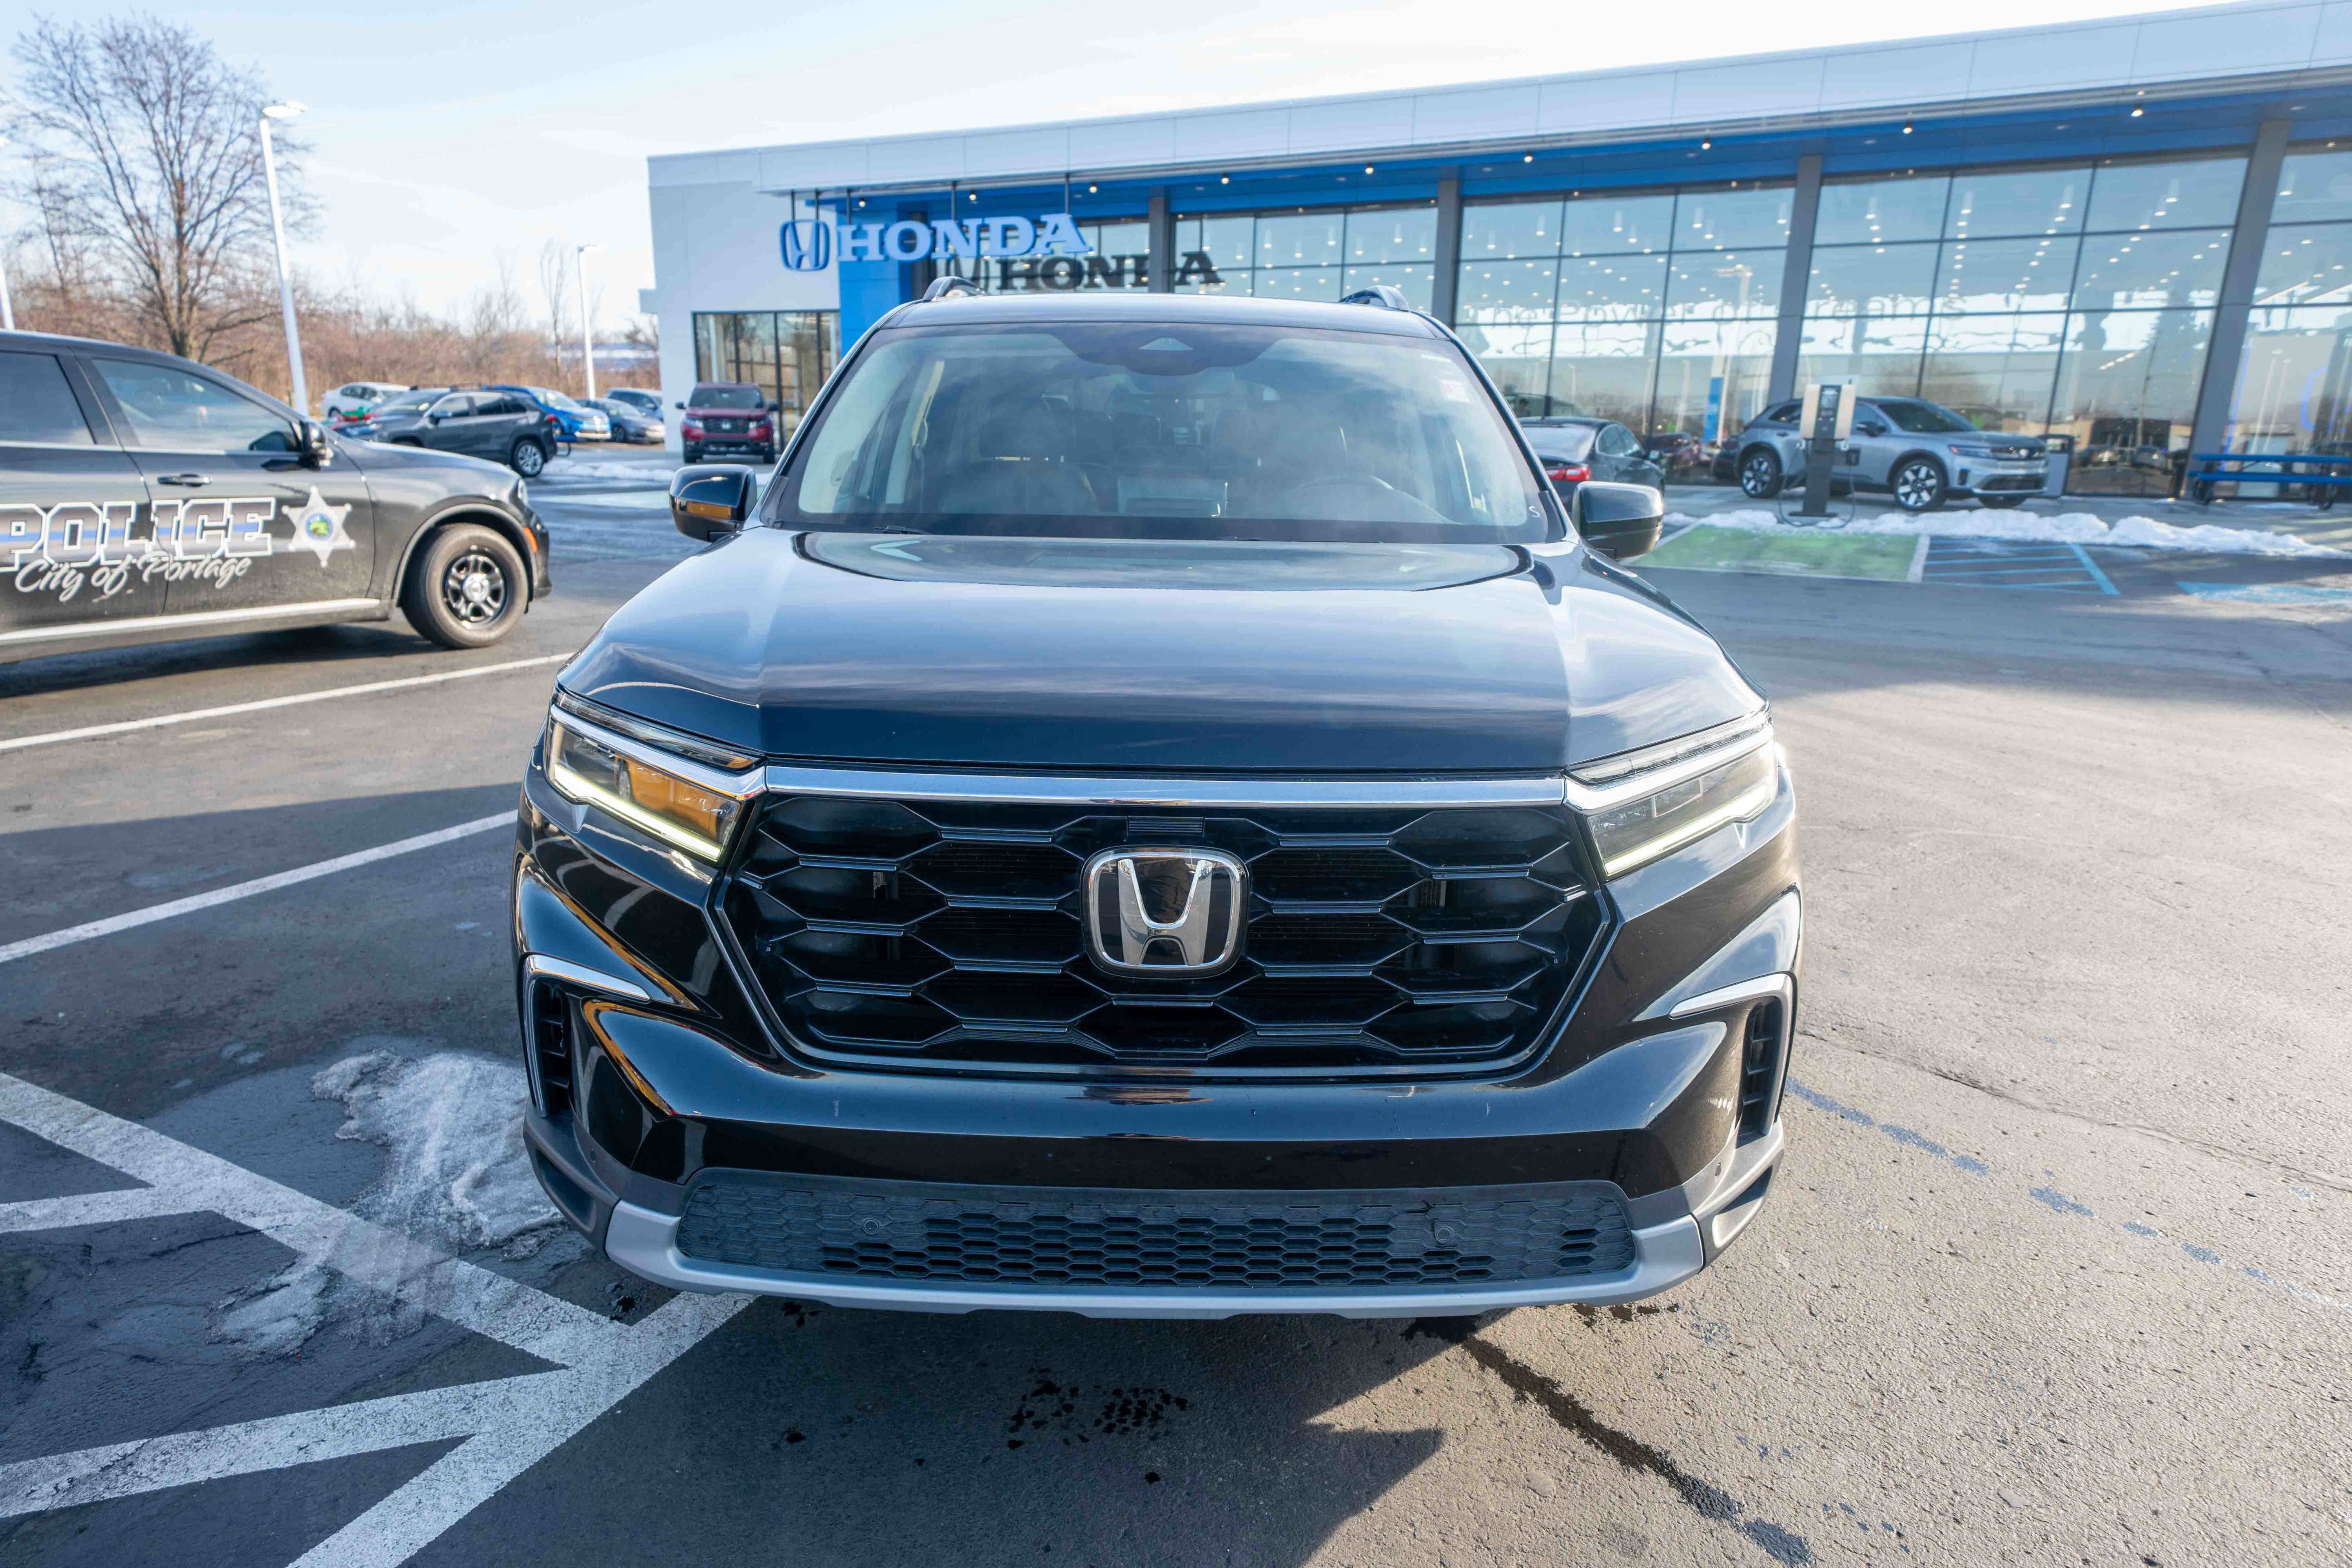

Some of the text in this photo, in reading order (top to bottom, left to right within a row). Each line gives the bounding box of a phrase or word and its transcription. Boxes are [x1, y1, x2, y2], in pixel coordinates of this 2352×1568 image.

[837, 213, 1093, 262] HONDA
[1814, 294, 1966, 321] reams
[0, 497, 276, 571] POLICE
[15, 551, 252, 602] City of Portage
